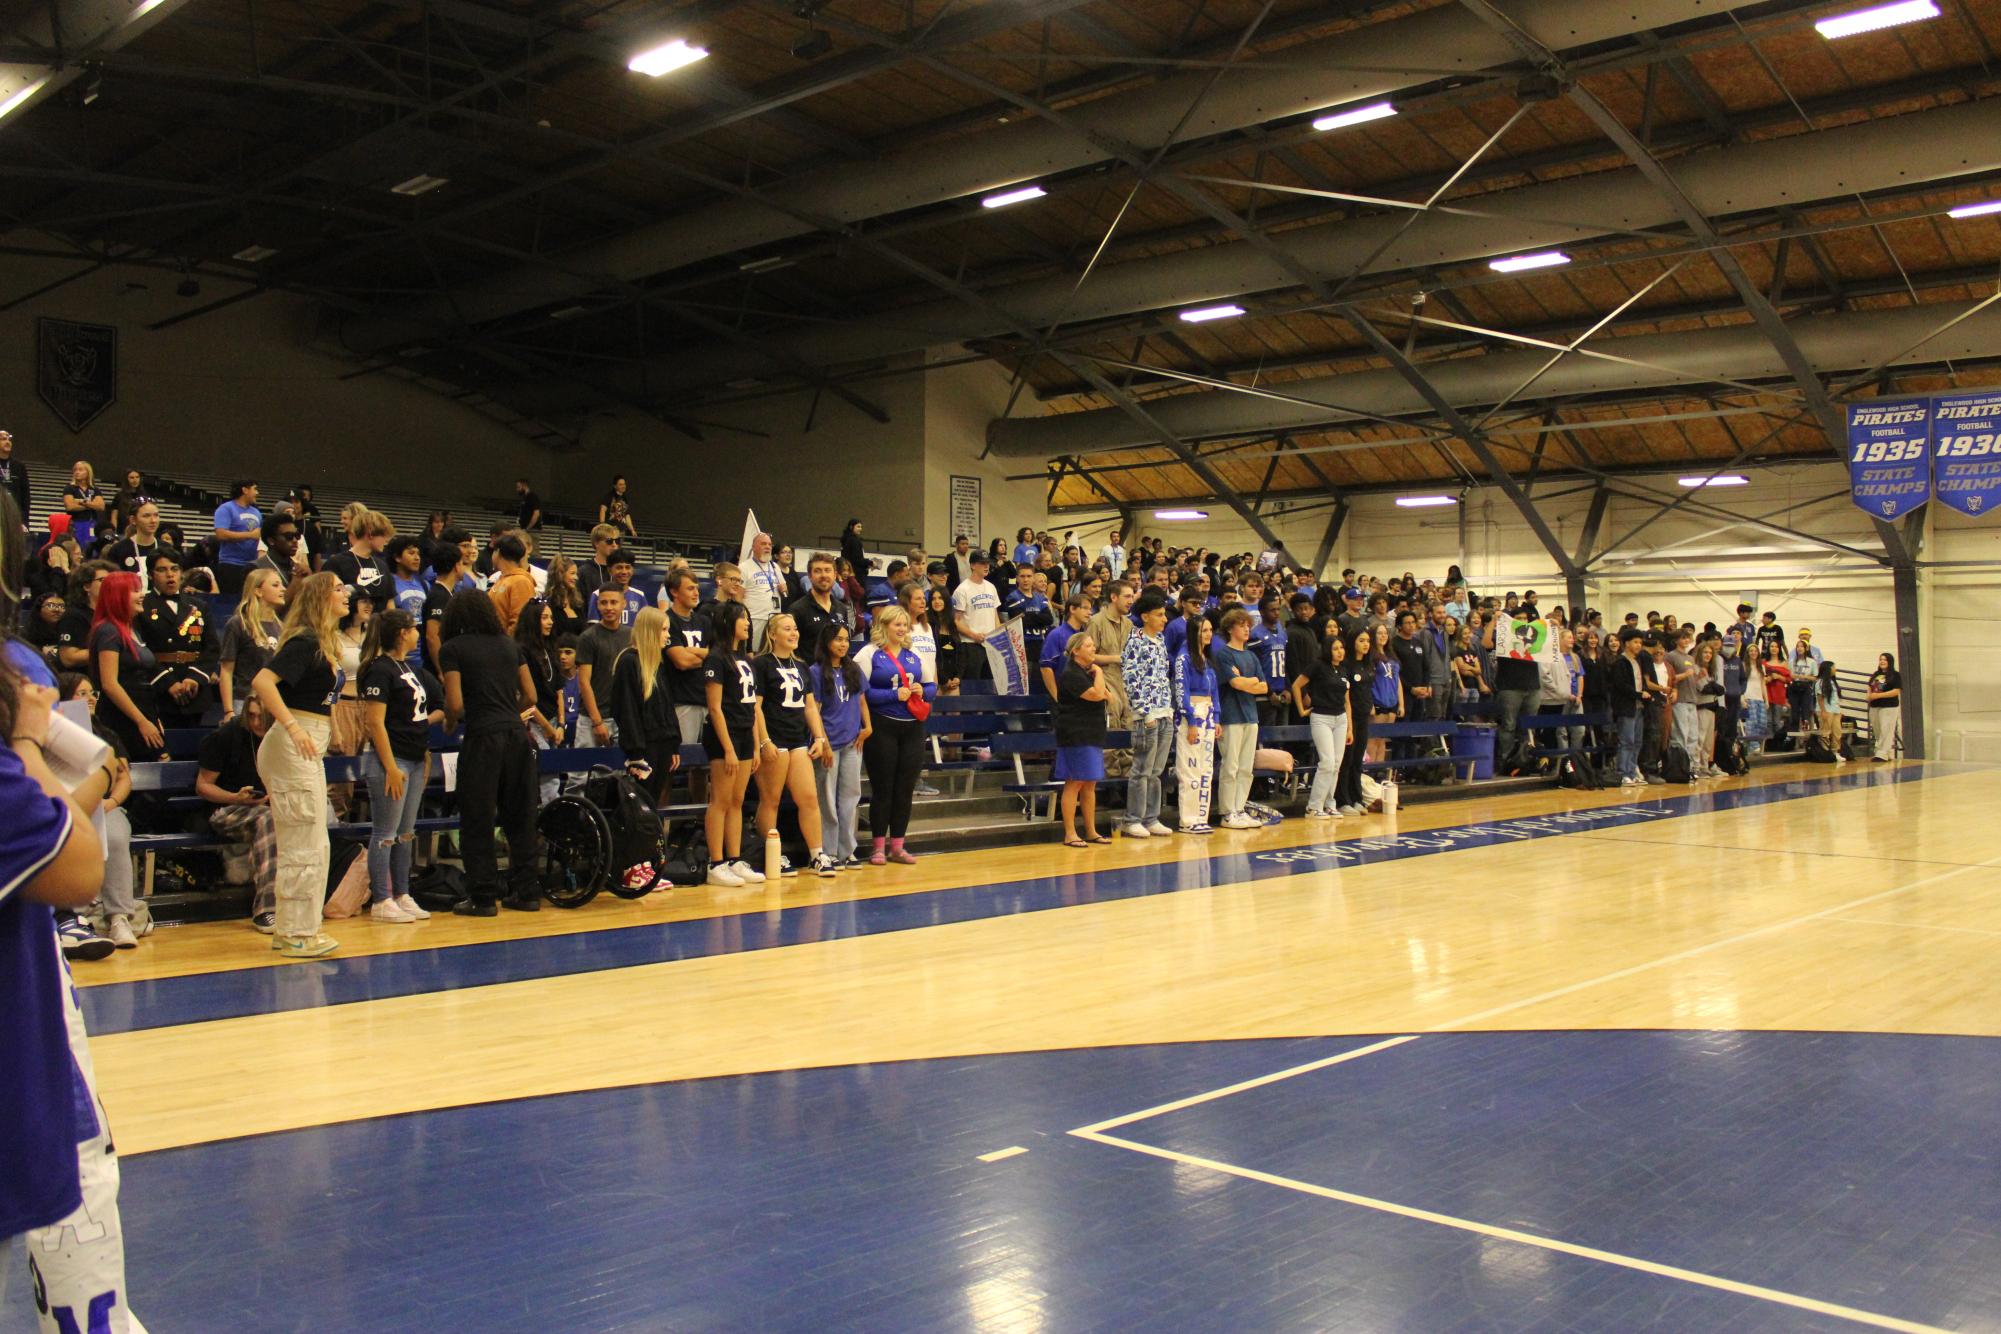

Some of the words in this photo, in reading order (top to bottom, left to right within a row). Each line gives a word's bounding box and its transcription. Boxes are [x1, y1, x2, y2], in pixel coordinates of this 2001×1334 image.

[1851, 409, 1927, 426] PIRATES
[1935, 403, 2001, 419] PIRATE
[1871, 428, 1905, 437] FOOTBALL
[1957, 422, 1993, 431] FOOTBALL
[1851, 437, 1926, 463] 1935
[1861, 467, 1916, 481] STATE
[1945, 461, 2001, 476] STATE
[1854, 481, 1927, 496] CHAMPS
[1937, 476, 2001, 492] CHAMP
[360, 567, 379, 579] NIKE
[431, 608, 443, 616] 20
[366, 686, 381, 696] 20
[775, 667, 806, 708] E
[568, 696, 576, 713] 2
[1255, 836, 1457, 863] Pirates
